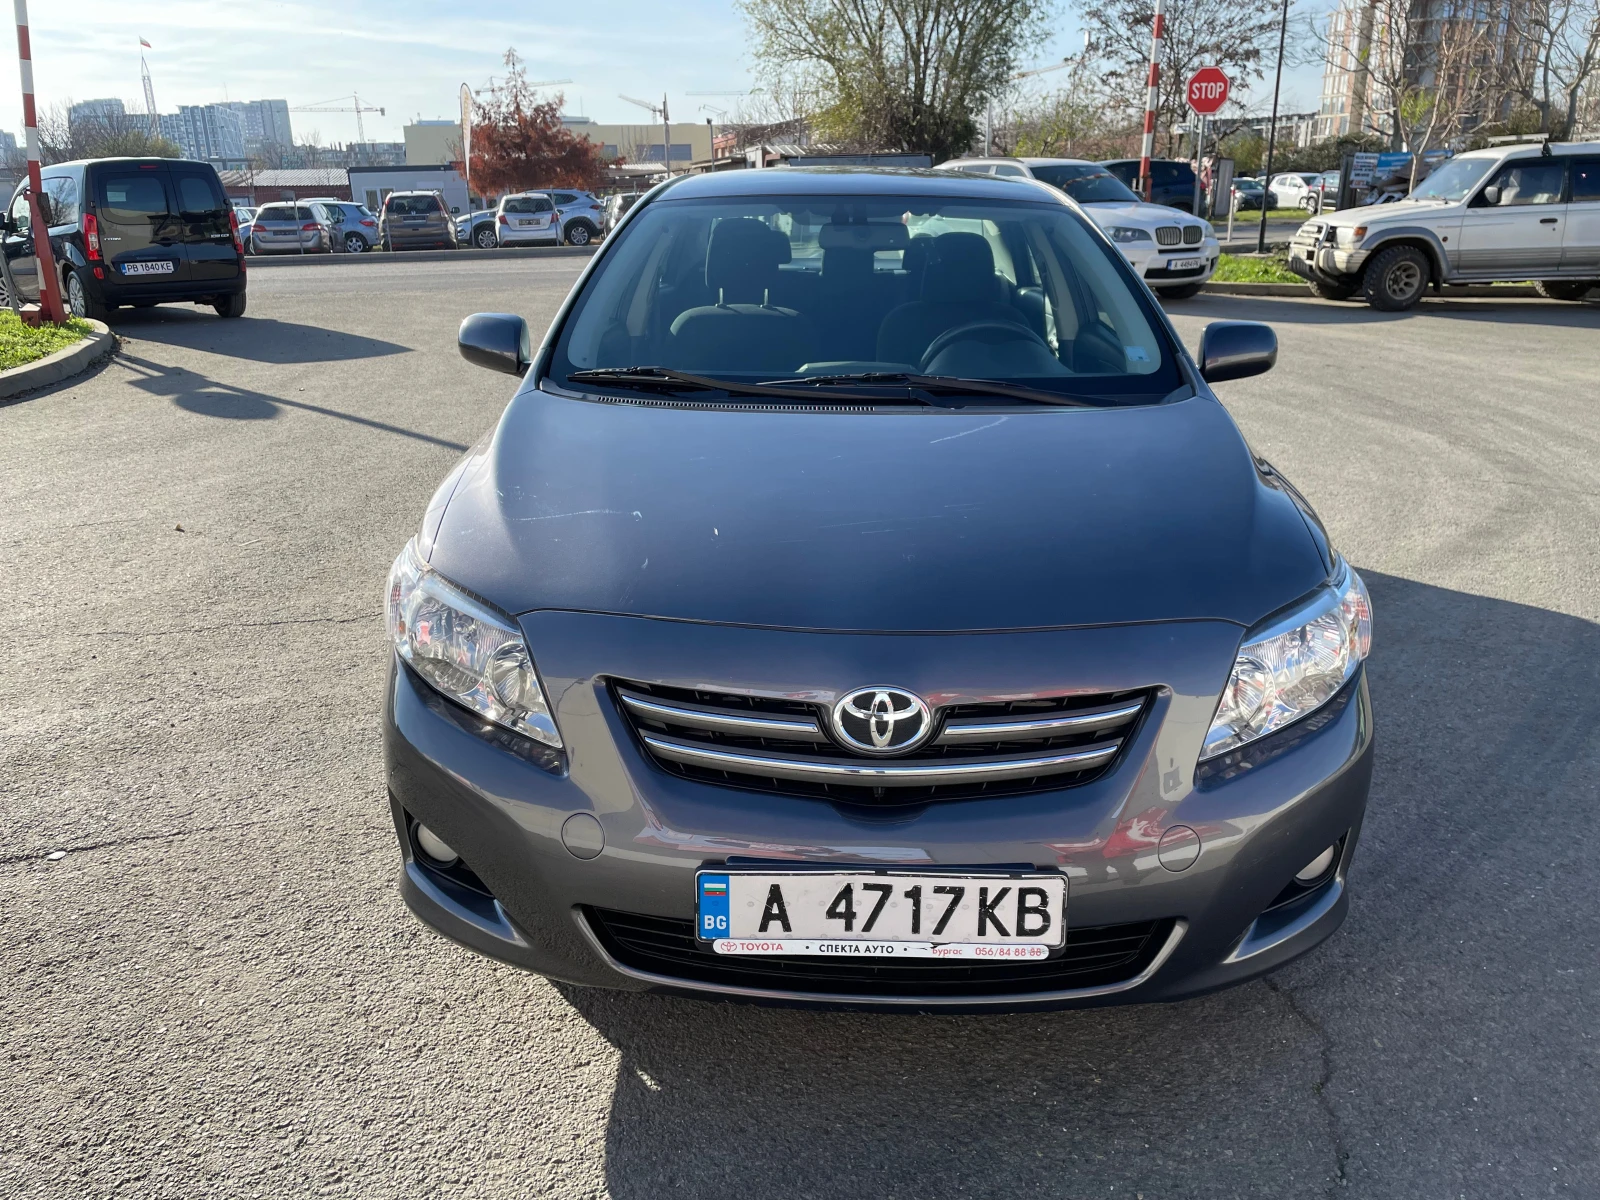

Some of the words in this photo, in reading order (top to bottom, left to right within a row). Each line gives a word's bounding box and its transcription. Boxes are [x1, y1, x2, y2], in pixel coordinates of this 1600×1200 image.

[1191, 82, 1225, 100] STOP
[127, 264, 139, 273] PB
[140, 263, 160, 272] 1840
[160, 262, 172, 271] KE
[758, 883, 792, 933] A
[826, 882, 965, 936] 4717
[977, 886, 1051, 937] KB
[704, 914, 727, 930] BG
[739, 943, 784, 952] TOYOTA
[819, 944, 861, 954] СПЕКТА
[864, 945, 894, 954] АУТО
[975, 947, 1011, 957] 056/84
[1014, 948, 1027, 957] 88
